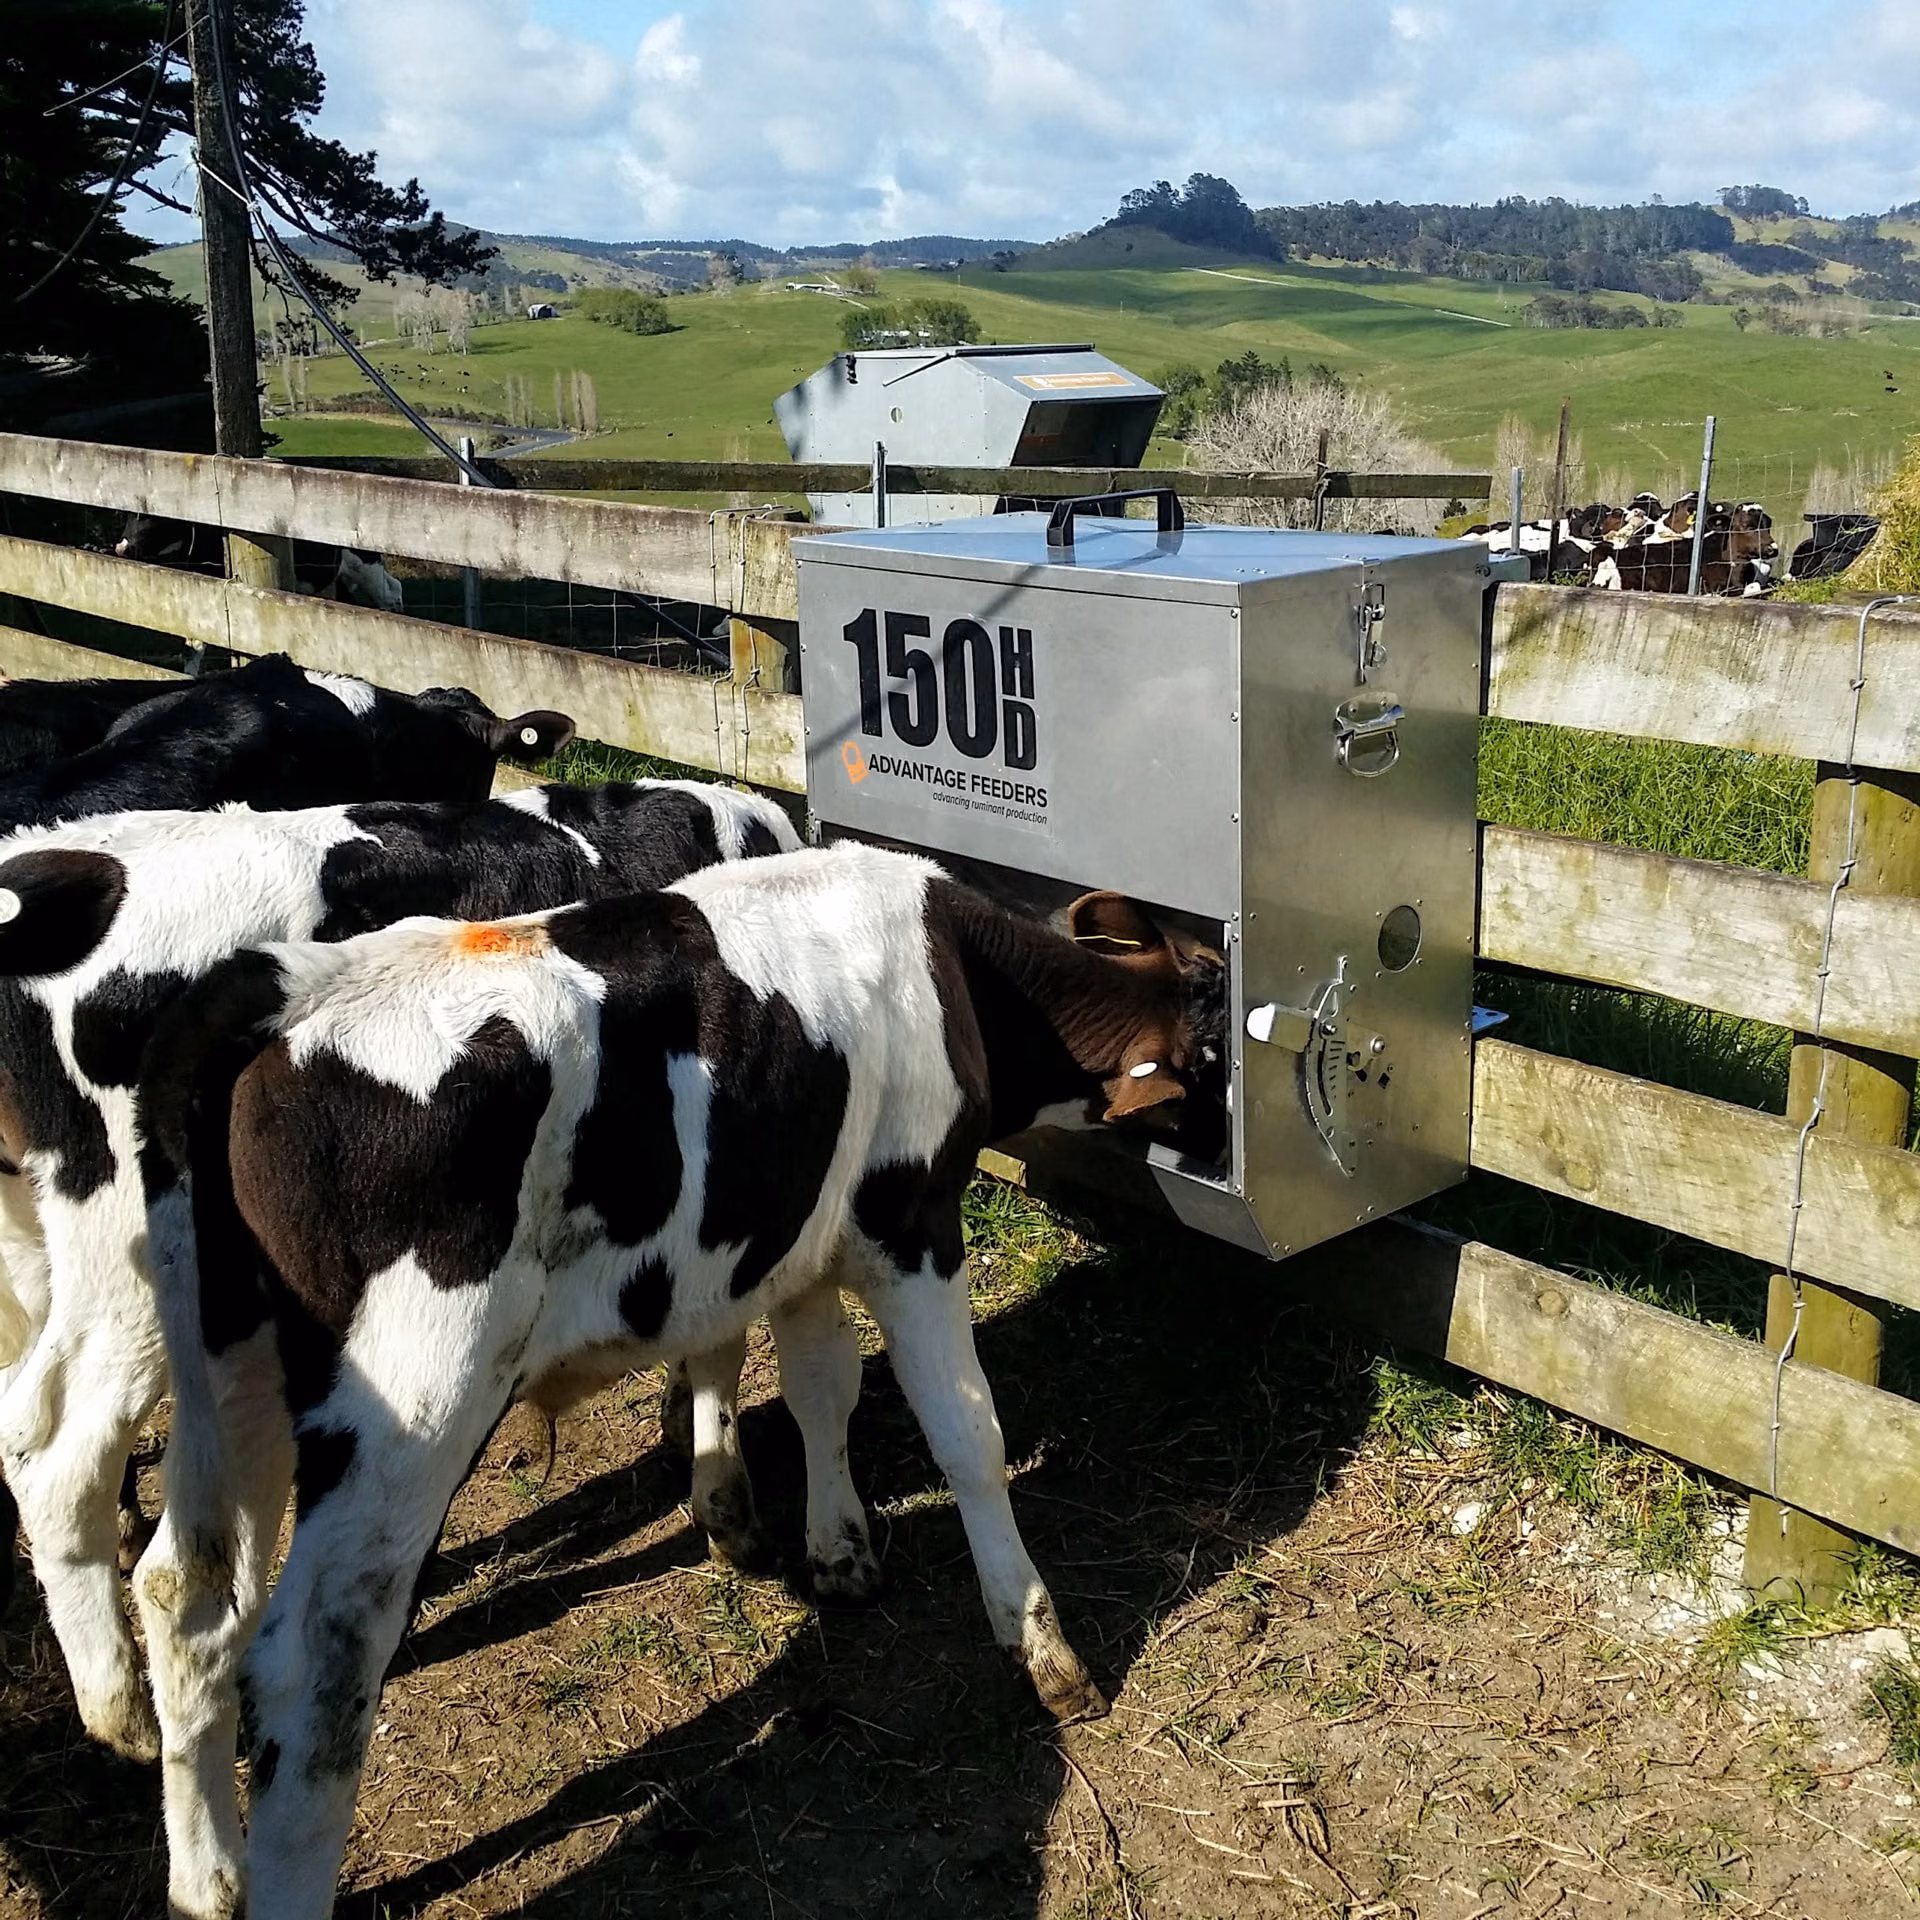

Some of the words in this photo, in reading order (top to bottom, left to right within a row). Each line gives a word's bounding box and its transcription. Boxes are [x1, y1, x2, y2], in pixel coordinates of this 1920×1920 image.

[843, 608, 998, 759] 150
[868, 754, 966, 791] ADVANTAGE
[971, 774, 1048, 808] FEEDERS
[932, 791, 970, 810] advancing
[971, 799, 1005, 815] ruminant
[1005, 807, 1048, 824] production
